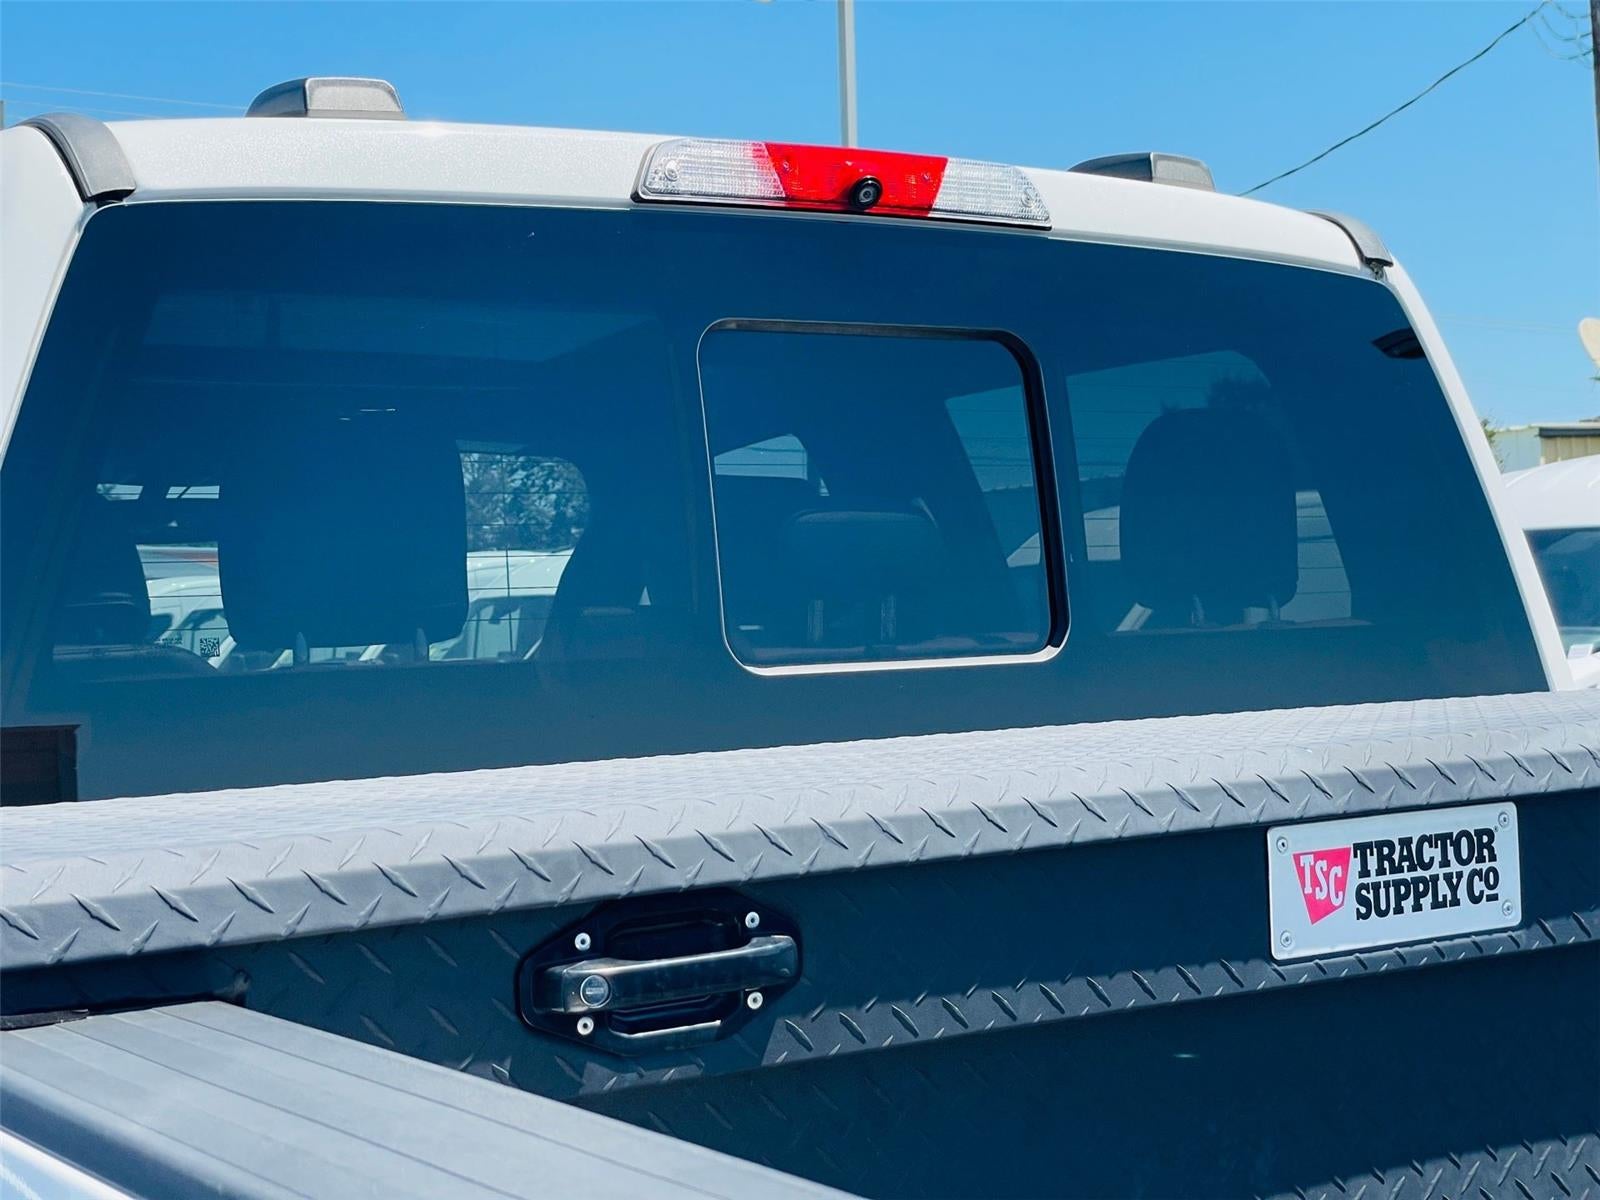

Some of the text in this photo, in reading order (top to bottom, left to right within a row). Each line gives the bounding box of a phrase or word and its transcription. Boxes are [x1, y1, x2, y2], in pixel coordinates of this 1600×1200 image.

[1353, 828, 1497, 879] TRACTOR
[1300, 854, 1343, 906] TSC
[1355, 871, 1464, 920] SUPPLY
